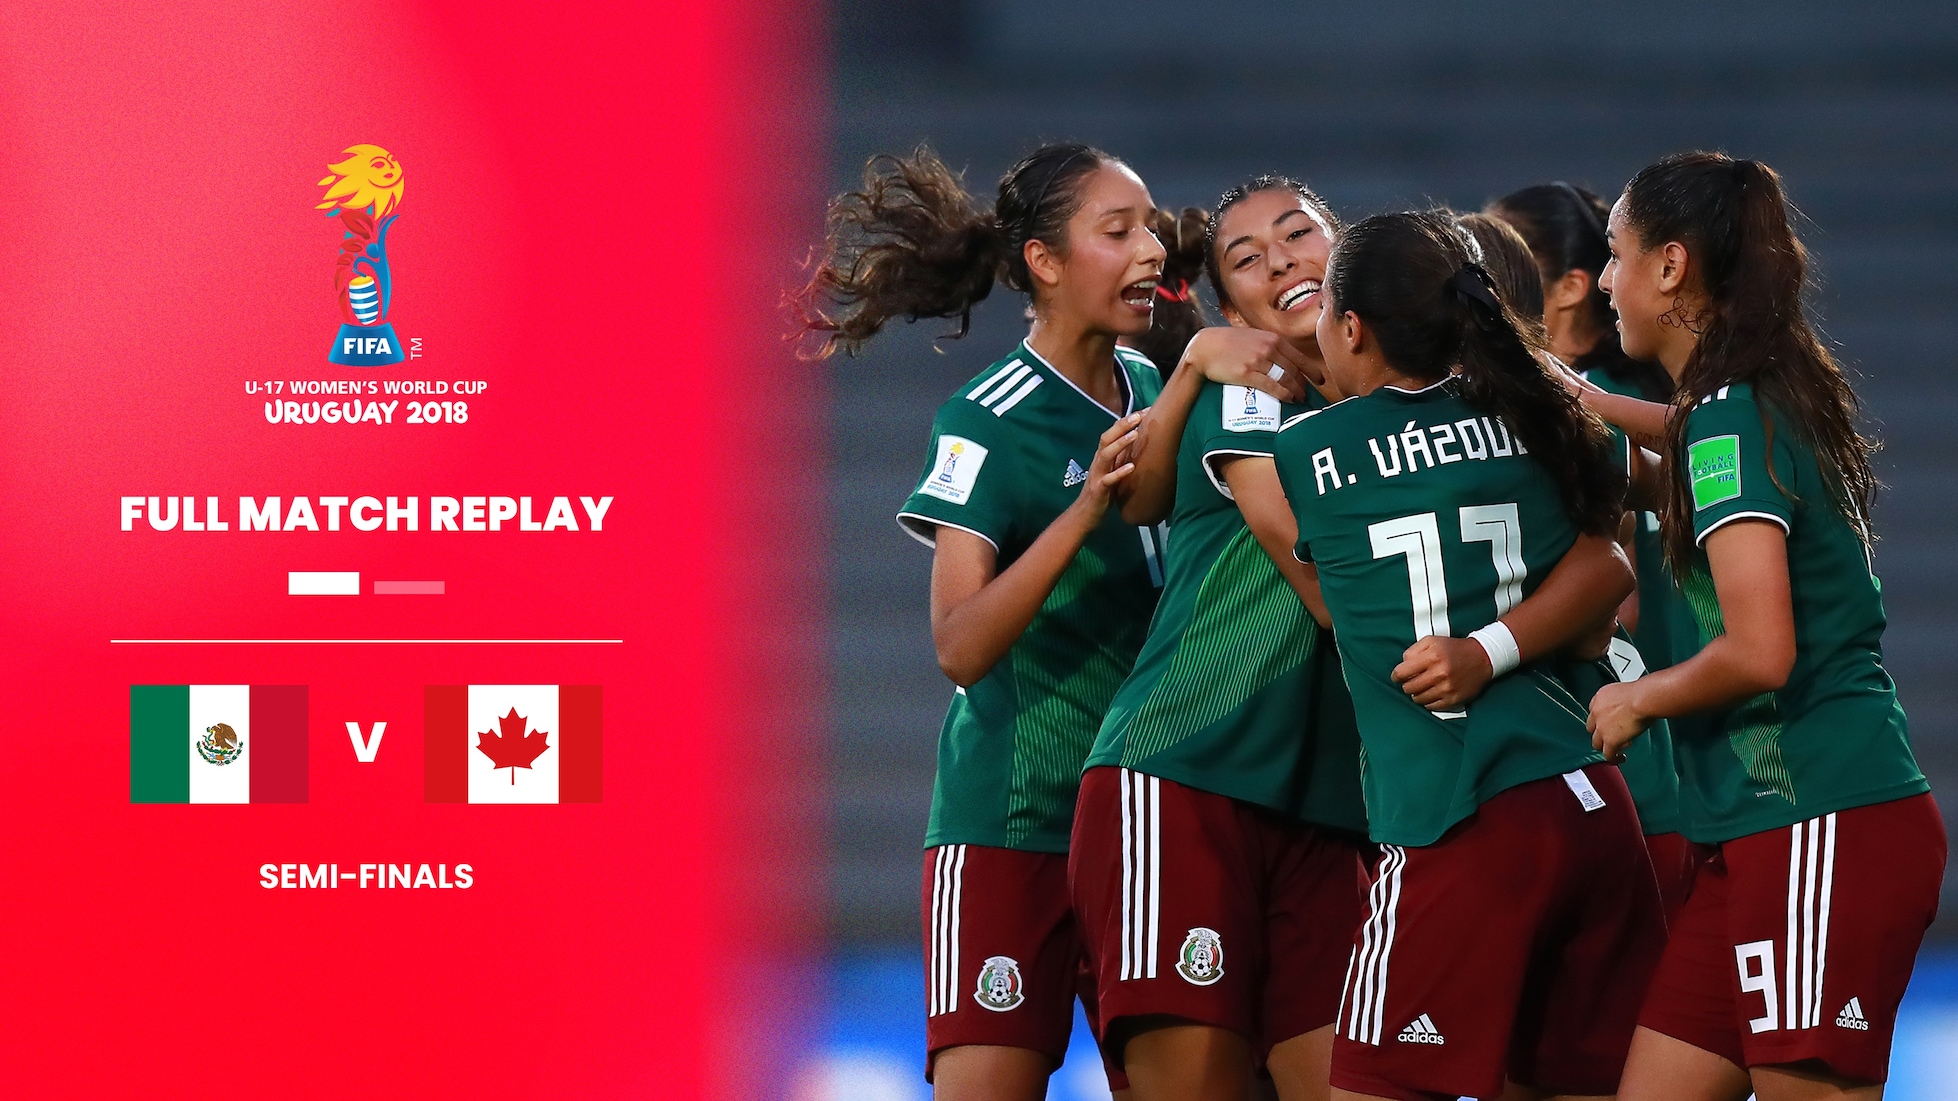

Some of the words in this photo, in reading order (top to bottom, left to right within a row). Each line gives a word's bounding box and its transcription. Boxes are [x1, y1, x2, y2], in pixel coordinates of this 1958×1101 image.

[1692, 453, 1734, 471] LIVING
[1311, 446, 1358, 496] A.
[1717, 473, 1735, 484] FIFA
[1734, 939, 1779, 1035] 9
[1835, 1015, 1869, 1031] adidas
[1397, 1031, 1445, 1046] adidas
